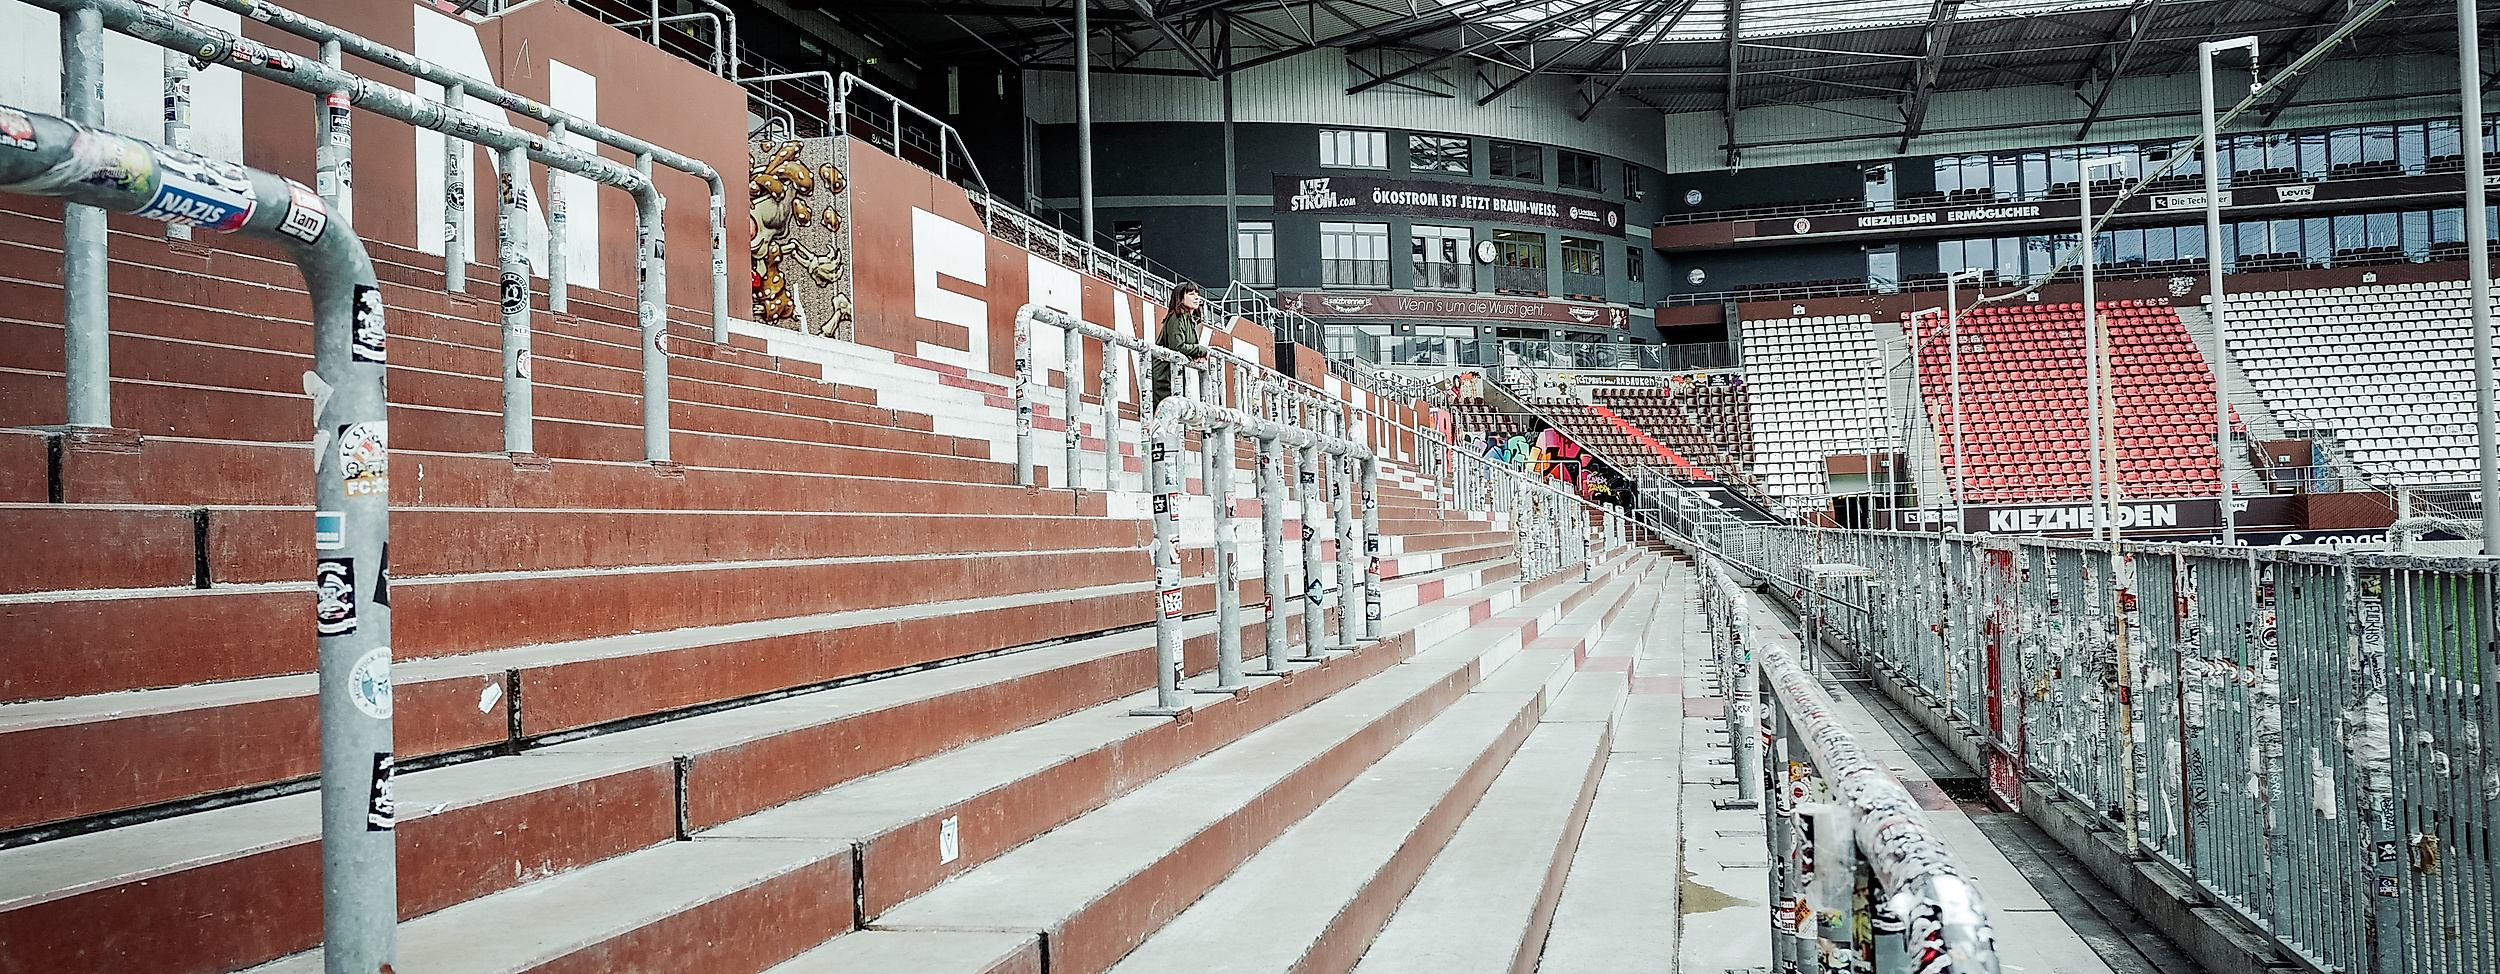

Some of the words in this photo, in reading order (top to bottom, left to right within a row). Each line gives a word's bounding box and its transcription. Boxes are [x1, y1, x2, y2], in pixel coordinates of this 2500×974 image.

[157, 191, 226, 224] NAZIS
[1373, 187, 1438, 206] ÖKOSTROM
[1441, 194, 1457, 208] IST
[1460, 198, 1490, 210] JETZT
[1493, 199, 1559, 218] BRAUN-WEISS.
[2171, 198, 2185, 206] Die
[292, 208, 319, 231] tam
[1858, 213, 1936, 227] KIEZHELDEN
[1947, 206, 2040, 222] ERMÖGLICHER
[1398, 298, 1442, 312] Wenn's
[1446, 302, 1465, 312] um
[1468, 300, 1486, 312] die
[1488, 302, 1517, 314] Wurst
[1519, 304, 1552, 318] geht...
[1988, 504, 2177, 532] KIEZHELDEN
